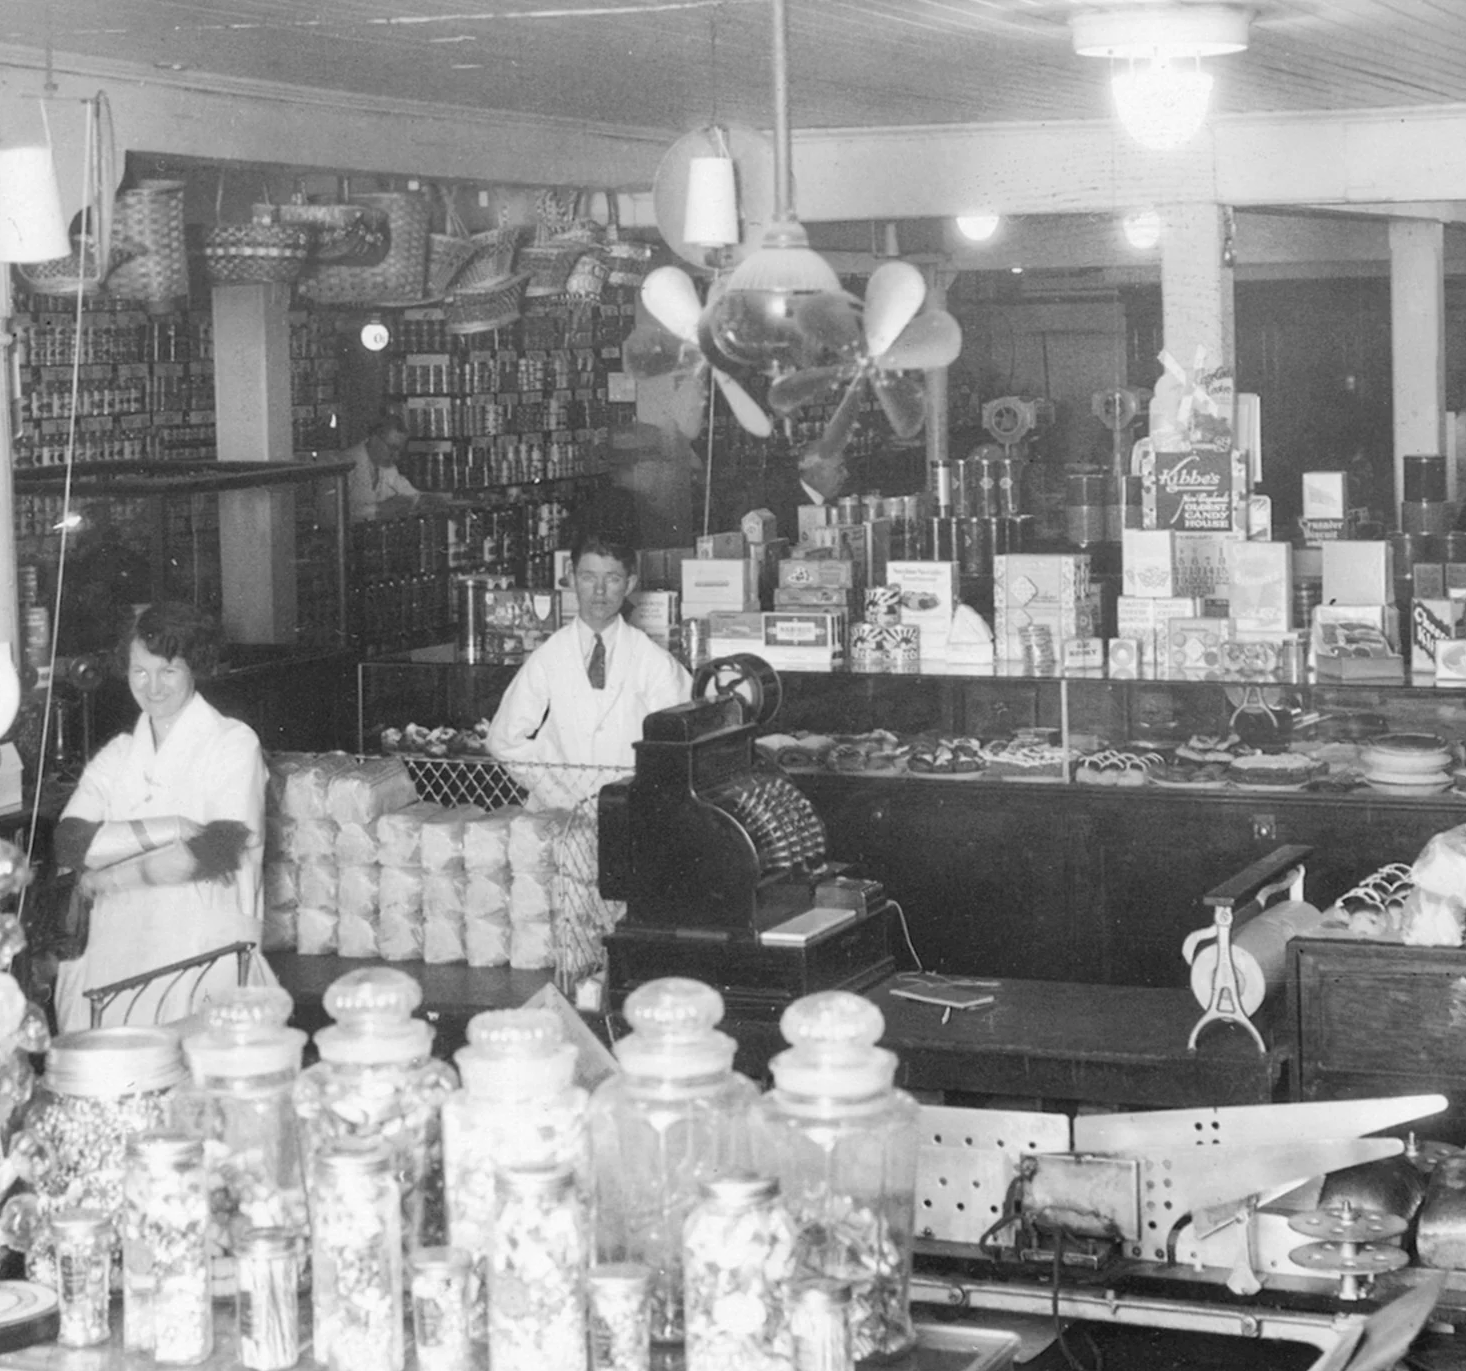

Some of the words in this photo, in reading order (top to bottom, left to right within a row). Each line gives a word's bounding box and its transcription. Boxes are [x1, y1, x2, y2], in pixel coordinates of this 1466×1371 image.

[1158, 457, 1222, 488] Kibbe's
[1184, 503, 1229, 511] OLDEST
[1184, 511, 1230, 520] CANDY
[1184, 519, 1229, 529] HOUSE
